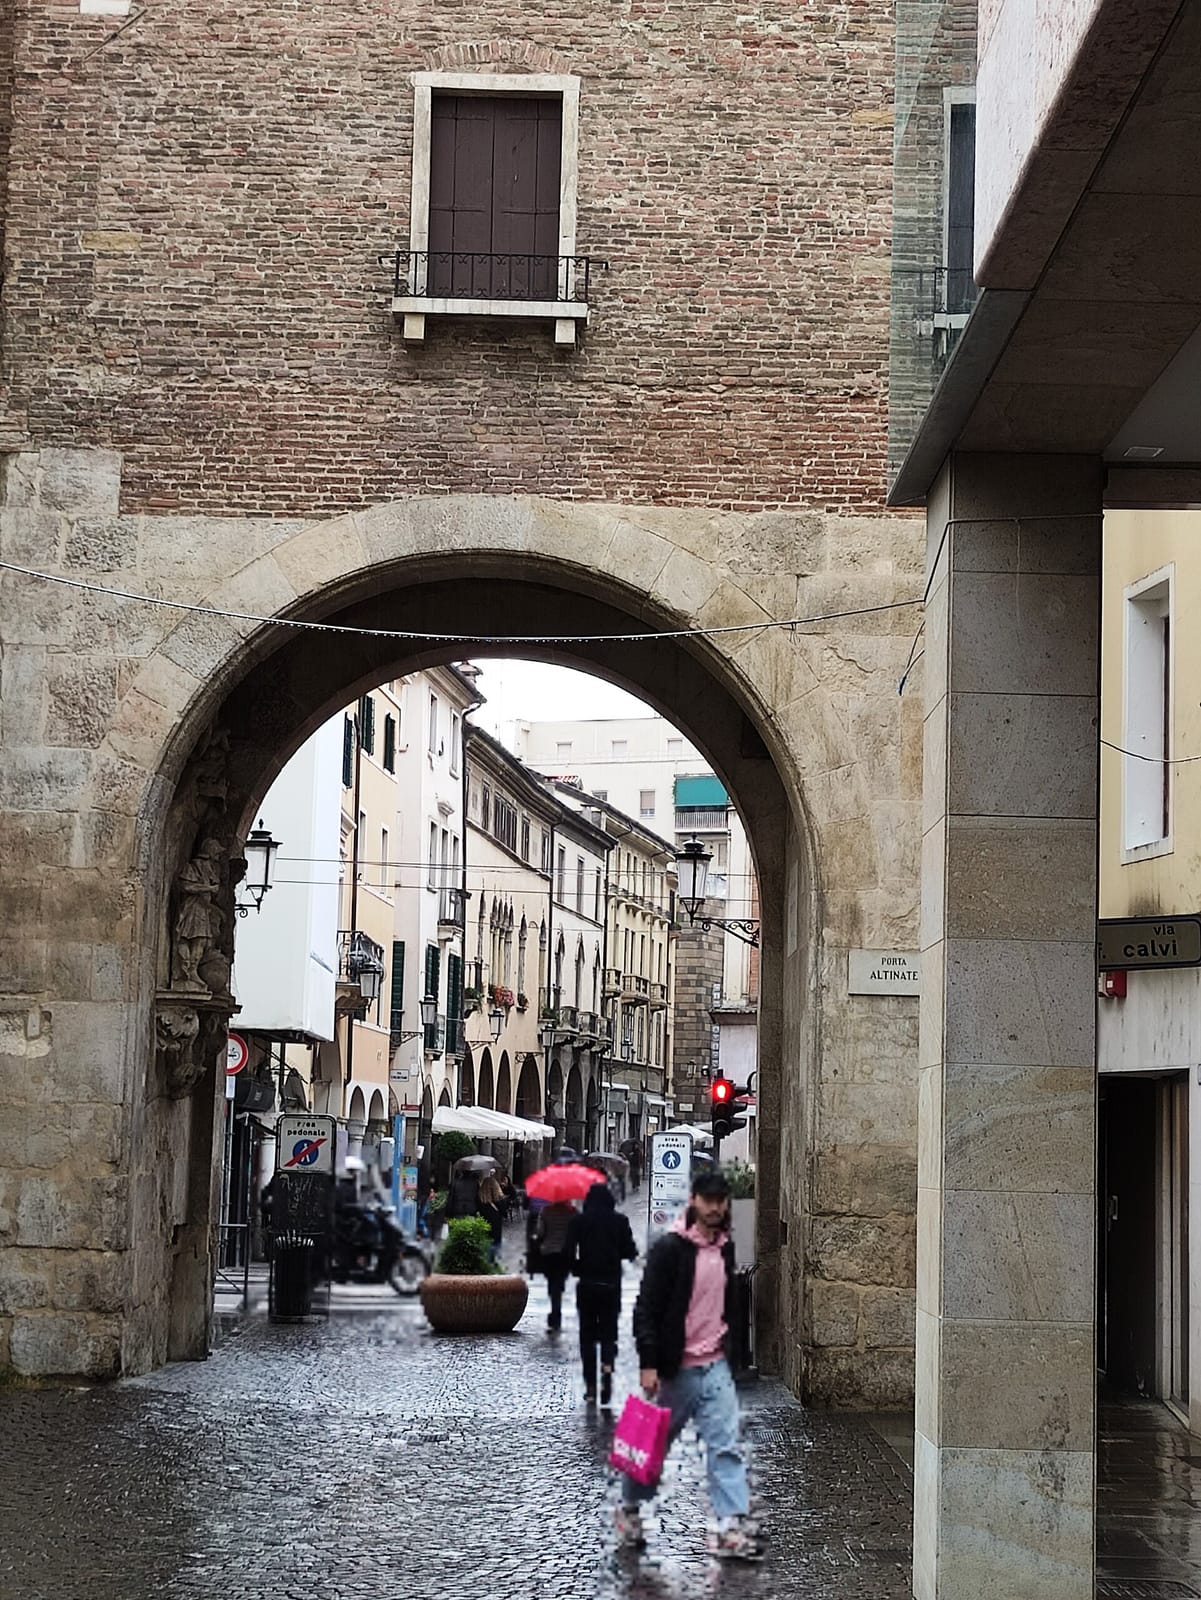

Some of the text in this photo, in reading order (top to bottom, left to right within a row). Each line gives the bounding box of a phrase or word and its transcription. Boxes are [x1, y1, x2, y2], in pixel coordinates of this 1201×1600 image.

[1153, 924, 1176, 936] via
[1123, 940, 1178, 959] calvi
[881, 957, 907, 966] PORTA
[870, 970, 919, 981] ALTINATE
[287, 1129, 326, 1137] pedonale
